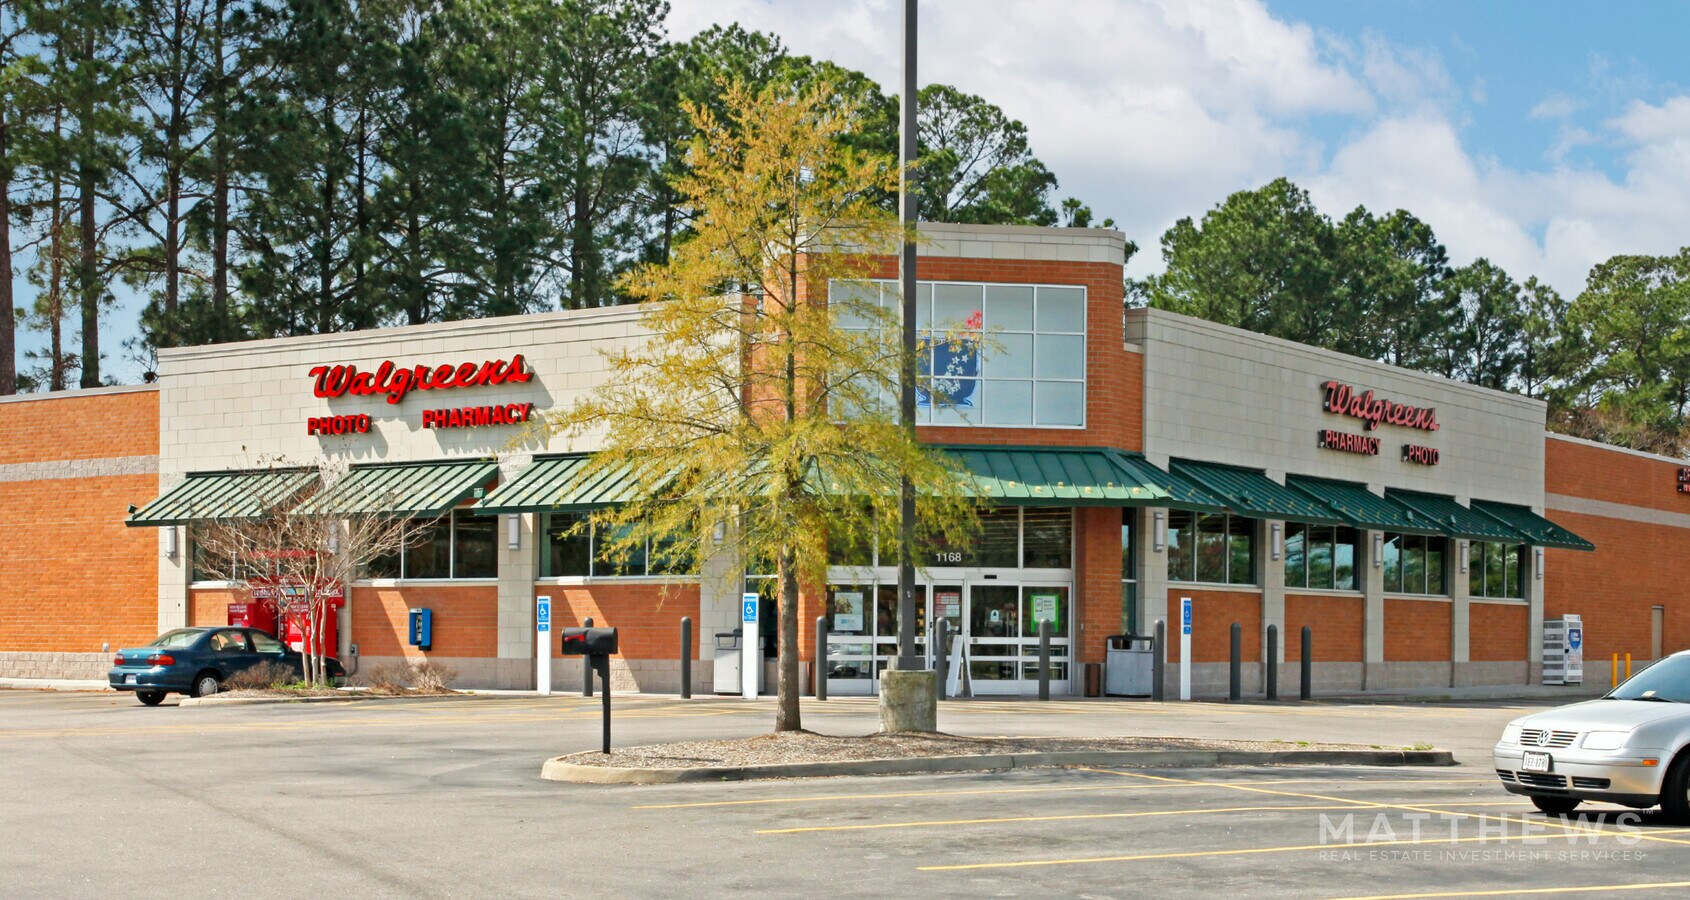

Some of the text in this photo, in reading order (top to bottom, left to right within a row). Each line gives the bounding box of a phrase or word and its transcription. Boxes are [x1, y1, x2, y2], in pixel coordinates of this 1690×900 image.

[308, 353, 533, 405] Walgreens
[422, 402, 533, 429] PHARMACY
[1321, 381, 1440, 431] Walgreens
[307, 413, 372, 436] PHOTO
[1324, 429, 1381, 456] PHARMACY
[1407, 444, 1440, 466] PHOTO
[936, 552, 962, 562] 1168
